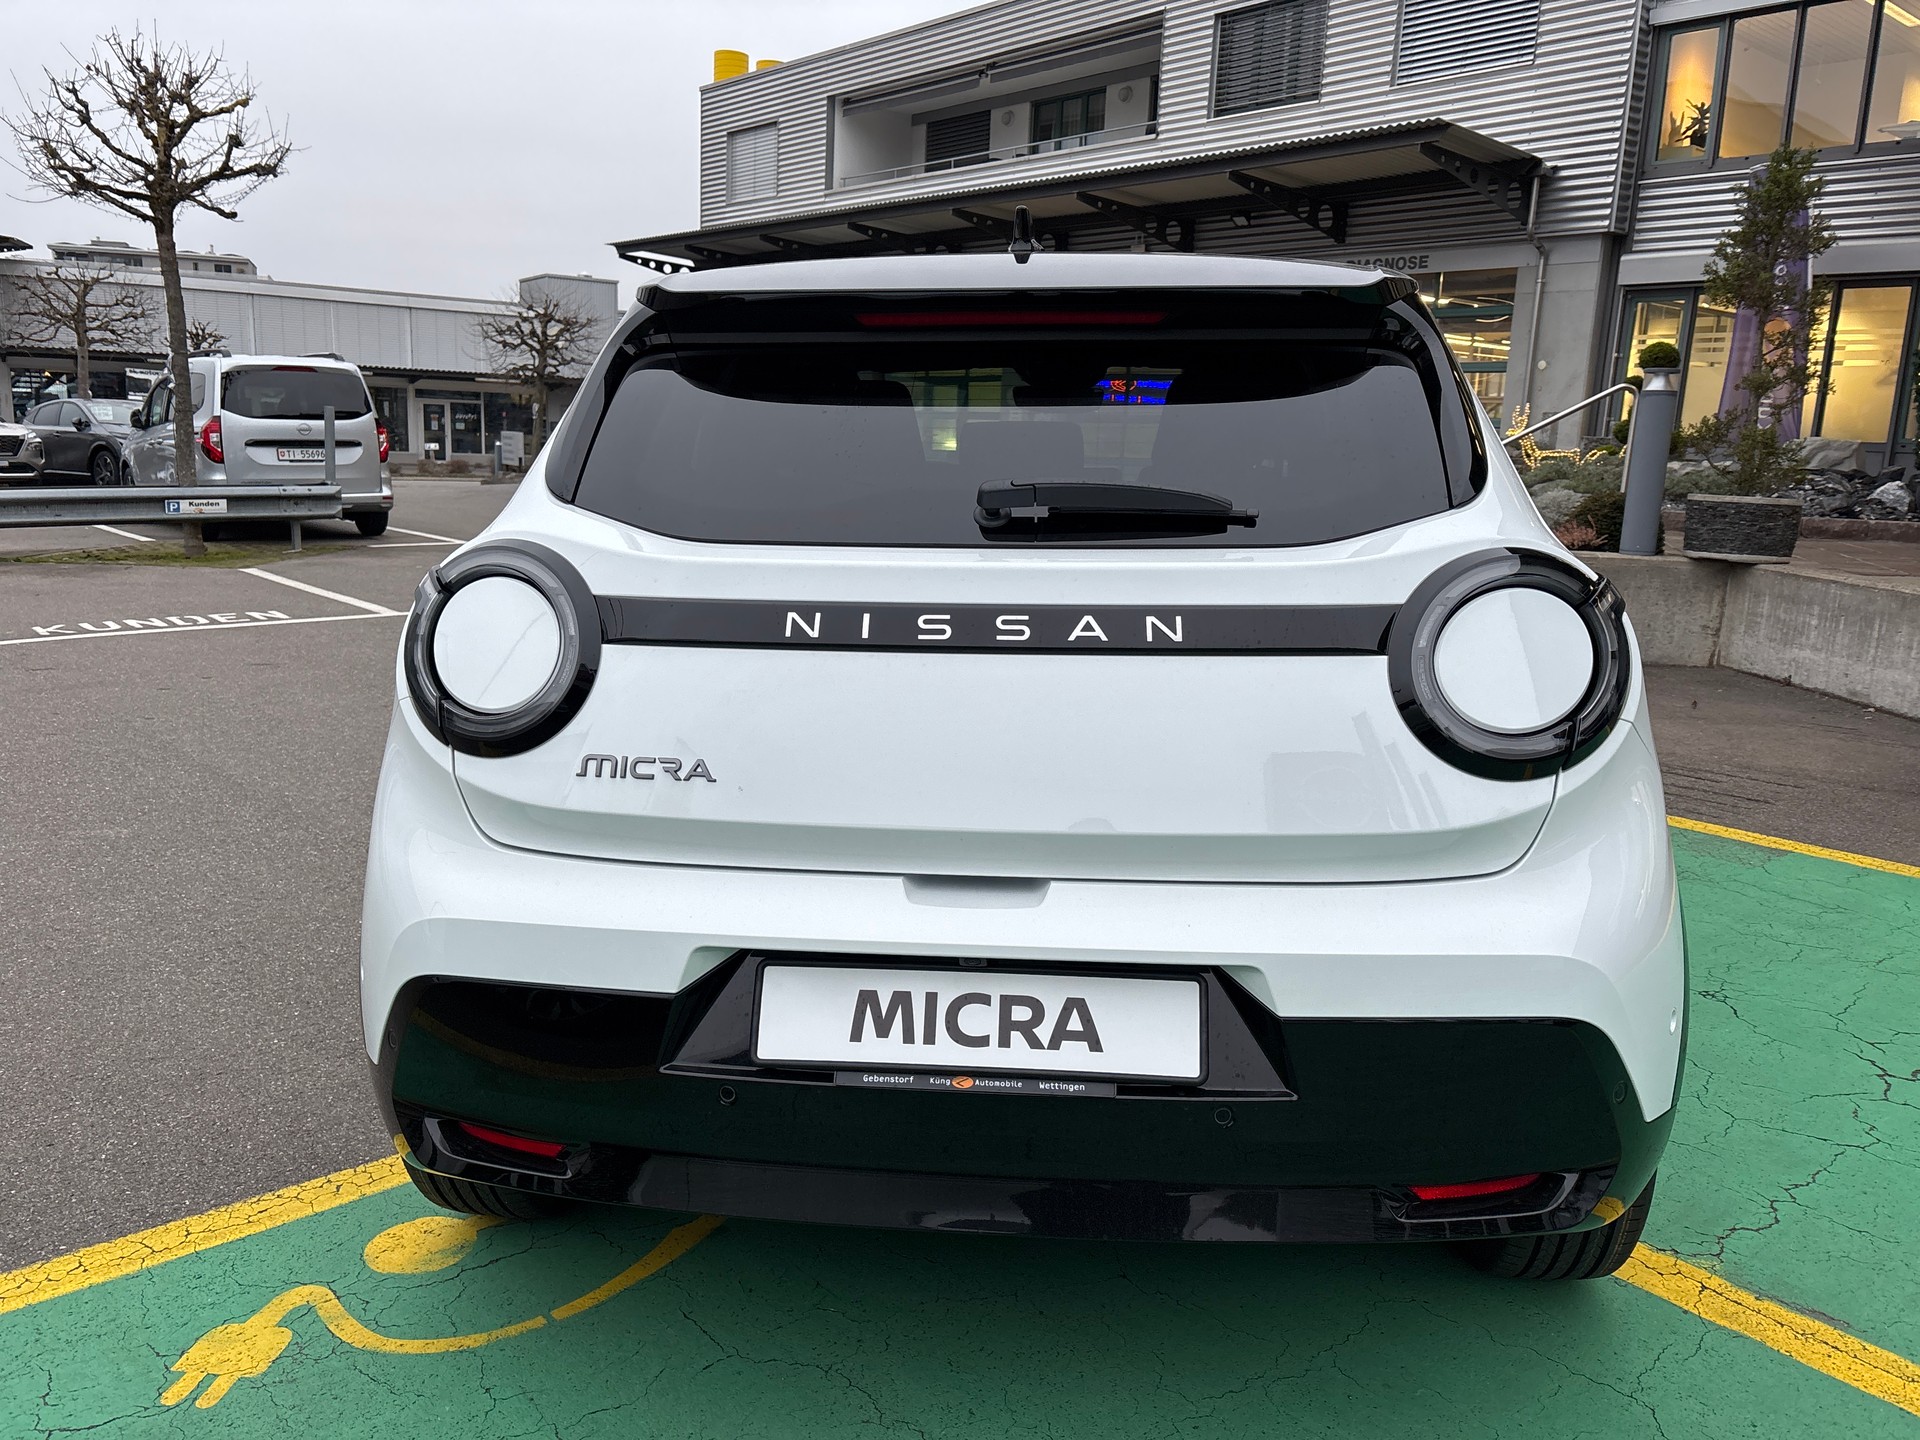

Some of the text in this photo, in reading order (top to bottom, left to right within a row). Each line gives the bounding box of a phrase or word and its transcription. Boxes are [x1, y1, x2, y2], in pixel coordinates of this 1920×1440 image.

[170, 502, 178, 512] P
[31, 610, 291, 636] KUNDEN
[785, 611, 1184, 642] NISSAN
[575, 753, 717, 782] MICRA
[849, 989, 1104, 1053] MICRA
[863, 1074, 1085, 1092] Gebenstorf Küng Automobile Wettingen
